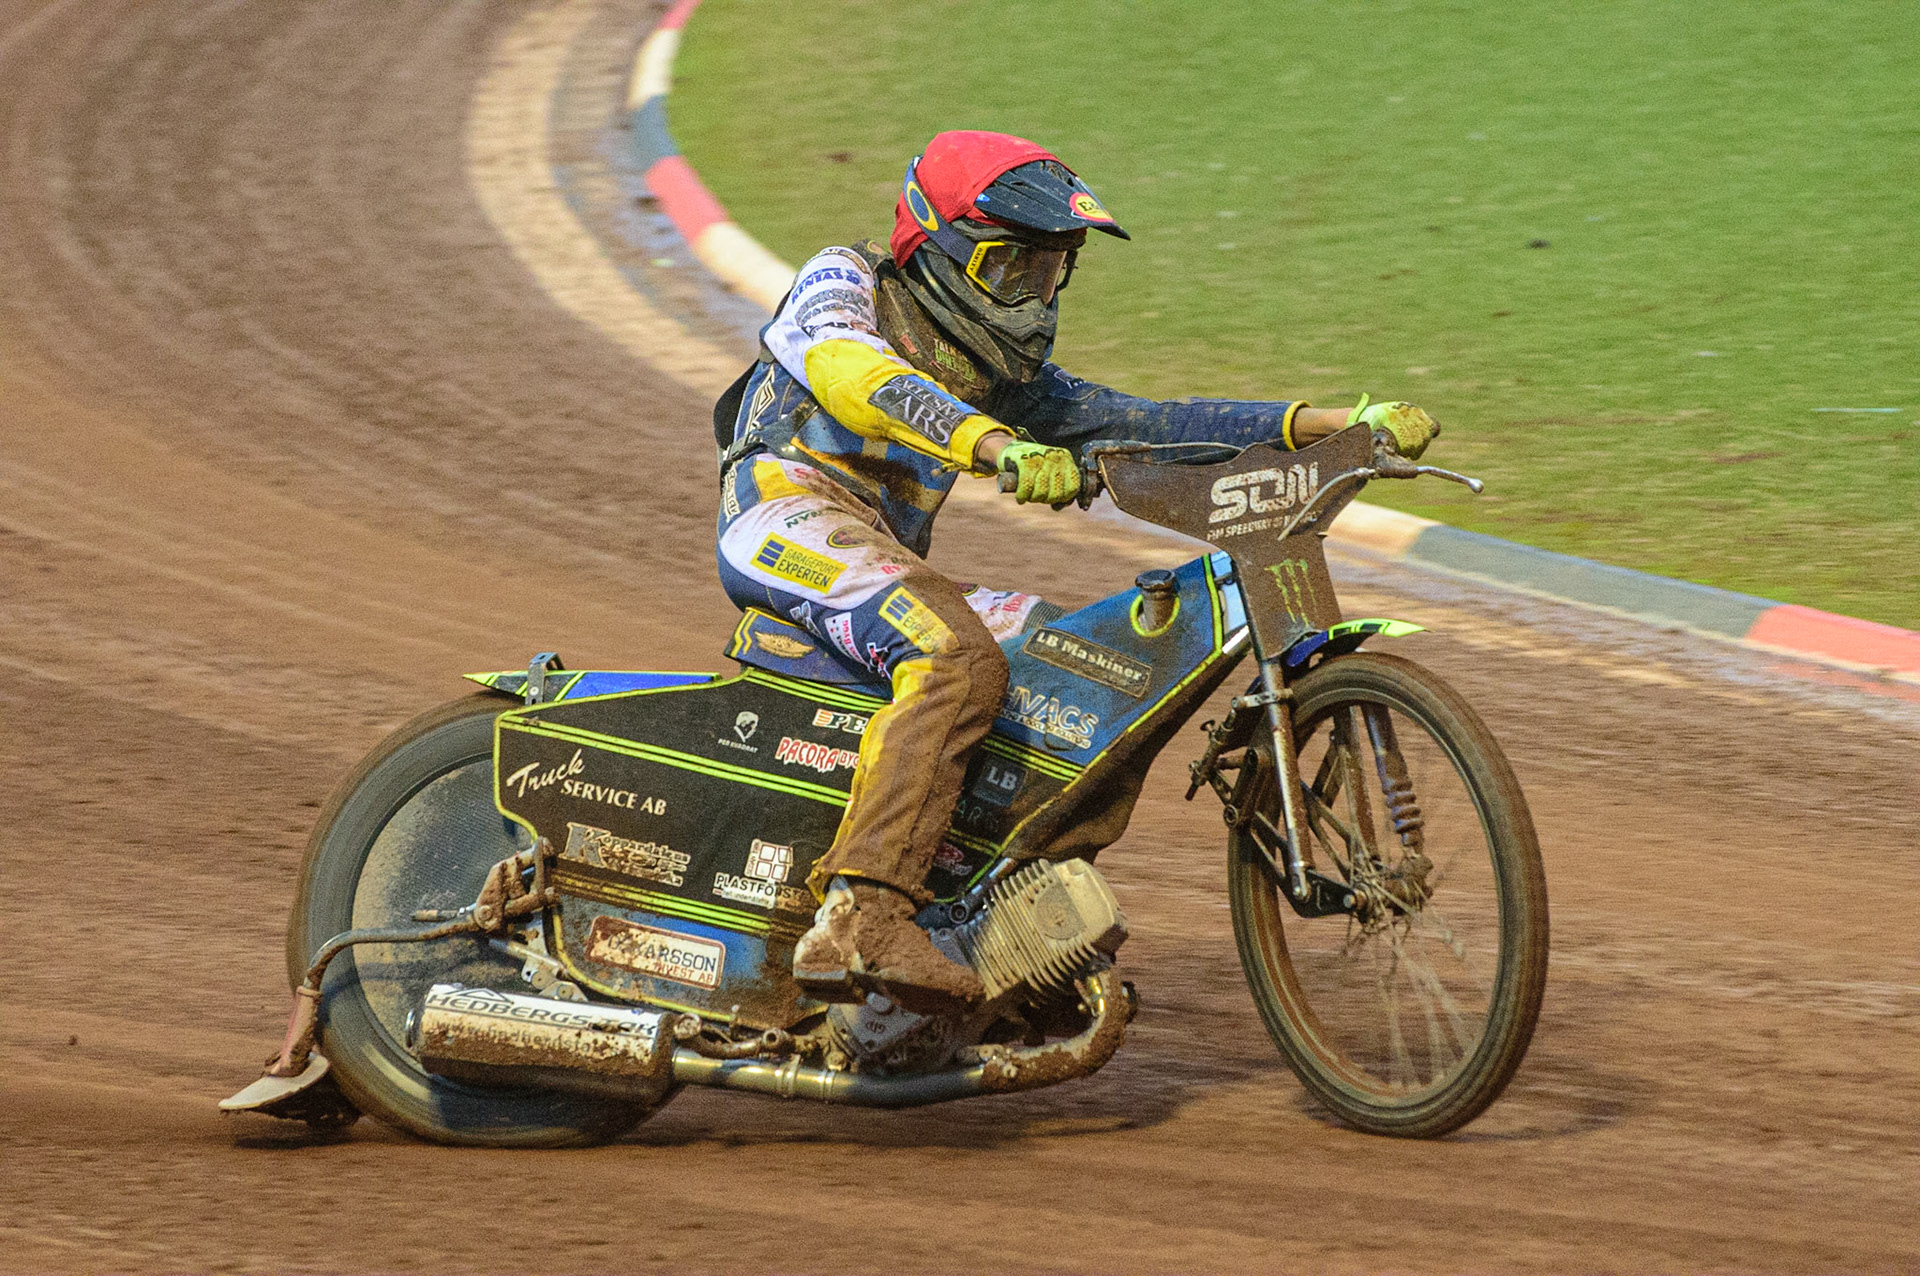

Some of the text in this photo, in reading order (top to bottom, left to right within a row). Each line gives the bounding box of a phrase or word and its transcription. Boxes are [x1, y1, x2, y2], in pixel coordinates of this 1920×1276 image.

[874, 385, 949, 444] CARS
[777, 559, 831, 588] EXPERTEN
[784, 548, 840, 575] GARAGEPORT
[1036, 632, 1142, 681] LB Maskiner
[775, 737, 840, 772] PACORA
[506, 748, 585, 798] Truck
[561, 779, 667, 816] SERVICE AB
[427, 994, 592, 1027] HEDBERGS
